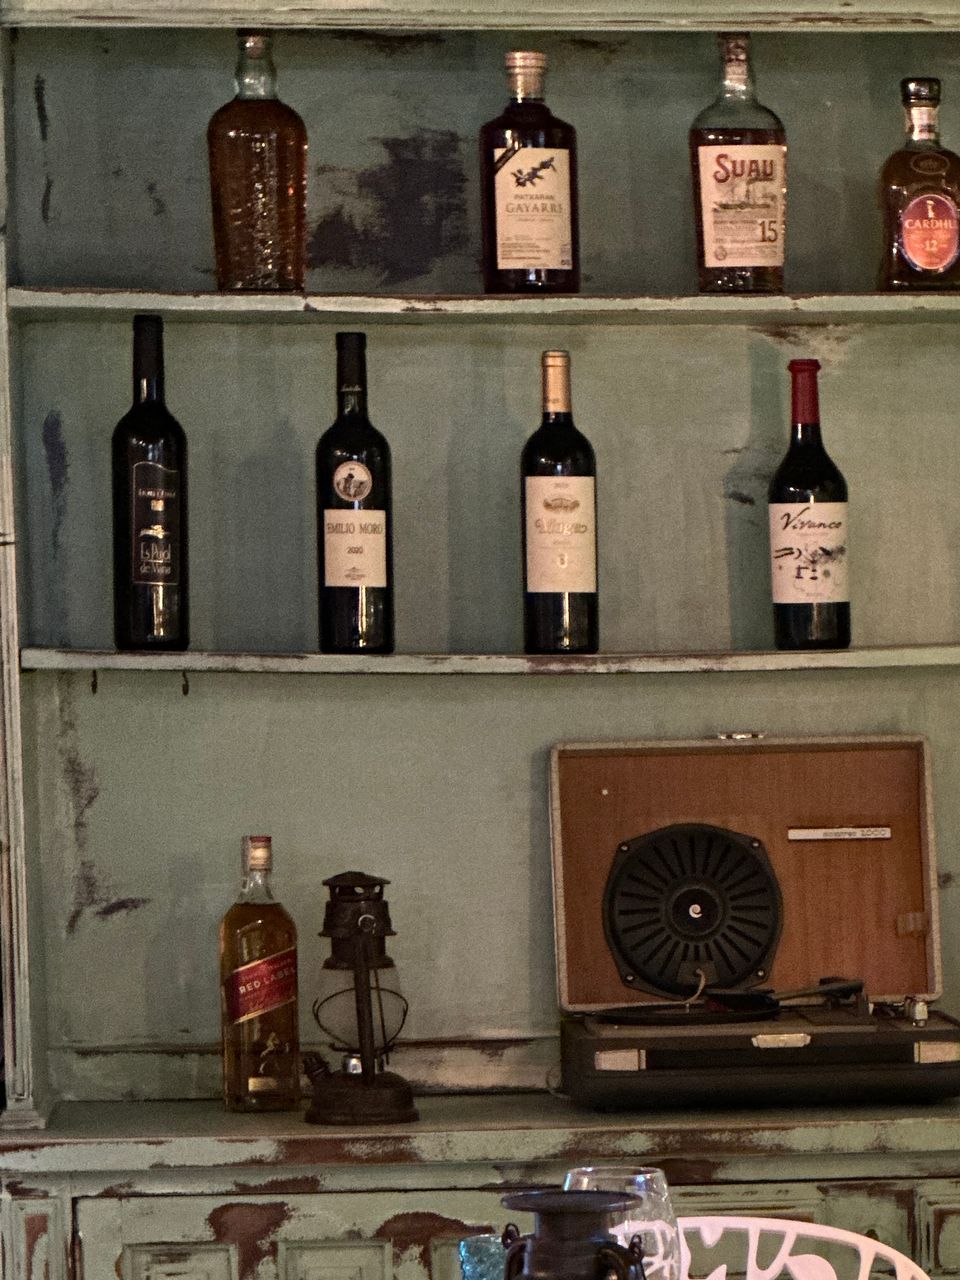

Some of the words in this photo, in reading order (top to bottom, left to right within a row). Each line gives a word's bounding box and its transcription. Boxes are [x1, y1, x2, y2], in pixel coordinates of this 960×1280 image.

[759, 220, 779, 243] 15
[925, 240, 938, 251] 12
[326, 523, 356, 534] EMILIO
[359, 523, 384, 535] MORO
[781, 506, 842, 531] Vivanco
[238, 980, 261, 994] RED
[262, 967, 296, 985] LABEL
